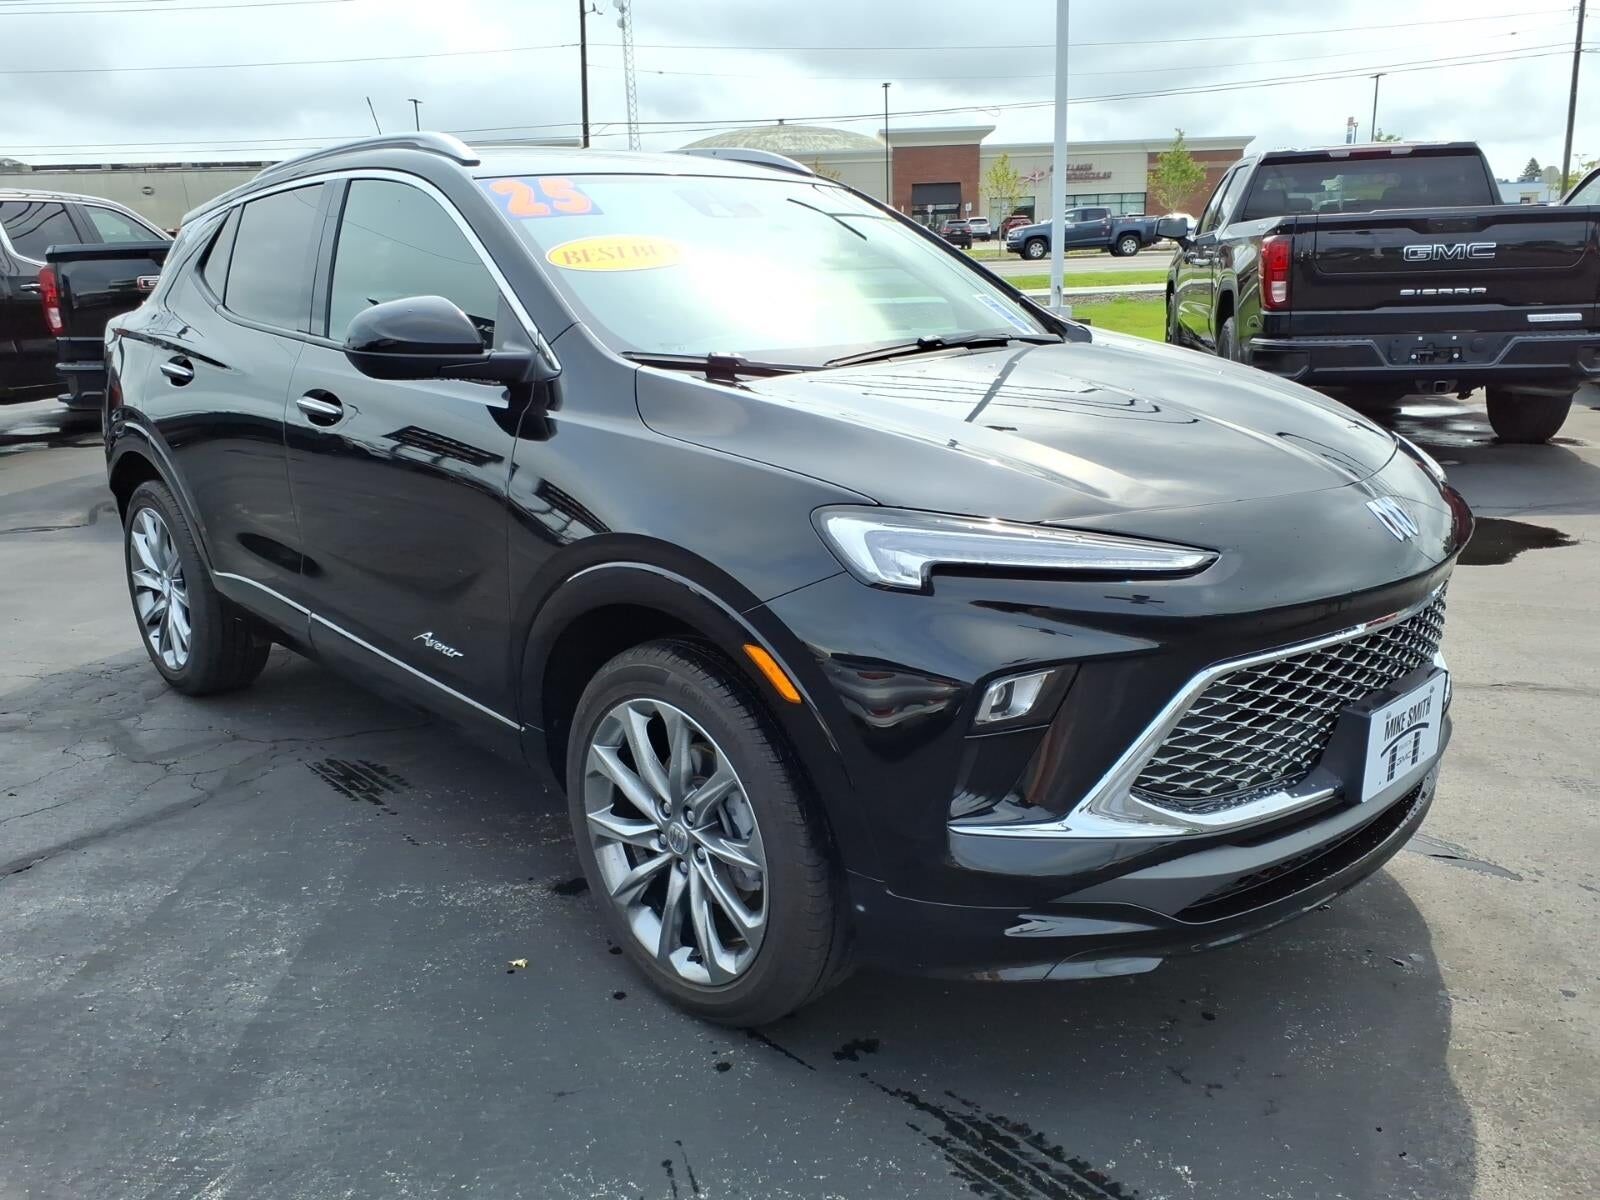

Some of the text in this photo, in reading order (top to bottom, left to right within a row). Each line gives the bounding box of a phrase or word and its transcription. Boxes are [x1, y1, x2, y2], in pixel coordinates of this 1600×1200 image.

[489, 177, 592, 217] 25
[1403, 242, 1497, 262] GMC
[1400, 287, 1487, 296] SIERRA
[1384, 695, 1432, 742] MIKE SMITH
